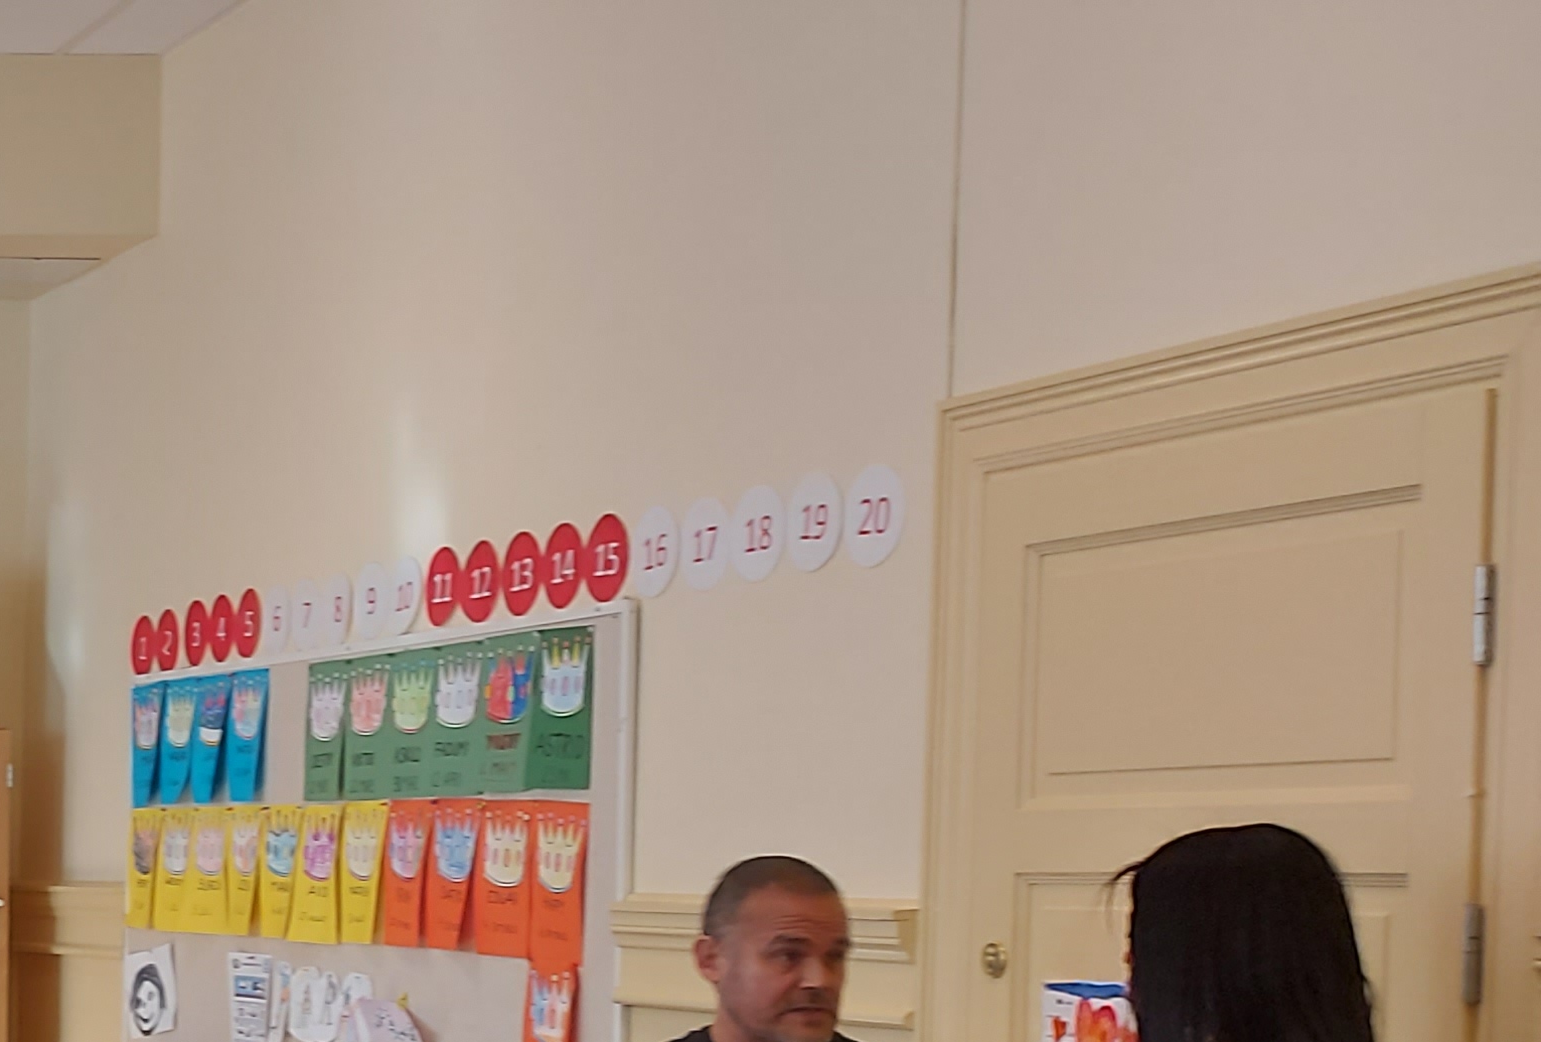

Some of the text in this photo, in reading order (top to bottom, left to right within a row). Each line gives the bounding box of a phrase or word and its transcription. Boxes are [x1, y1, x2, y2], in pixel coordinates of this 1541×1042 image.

[138, 497, 891, 660] 1 2 3 4 5 6 7 8 9 10 11 12 13 14 15 16 17 18 19 20
